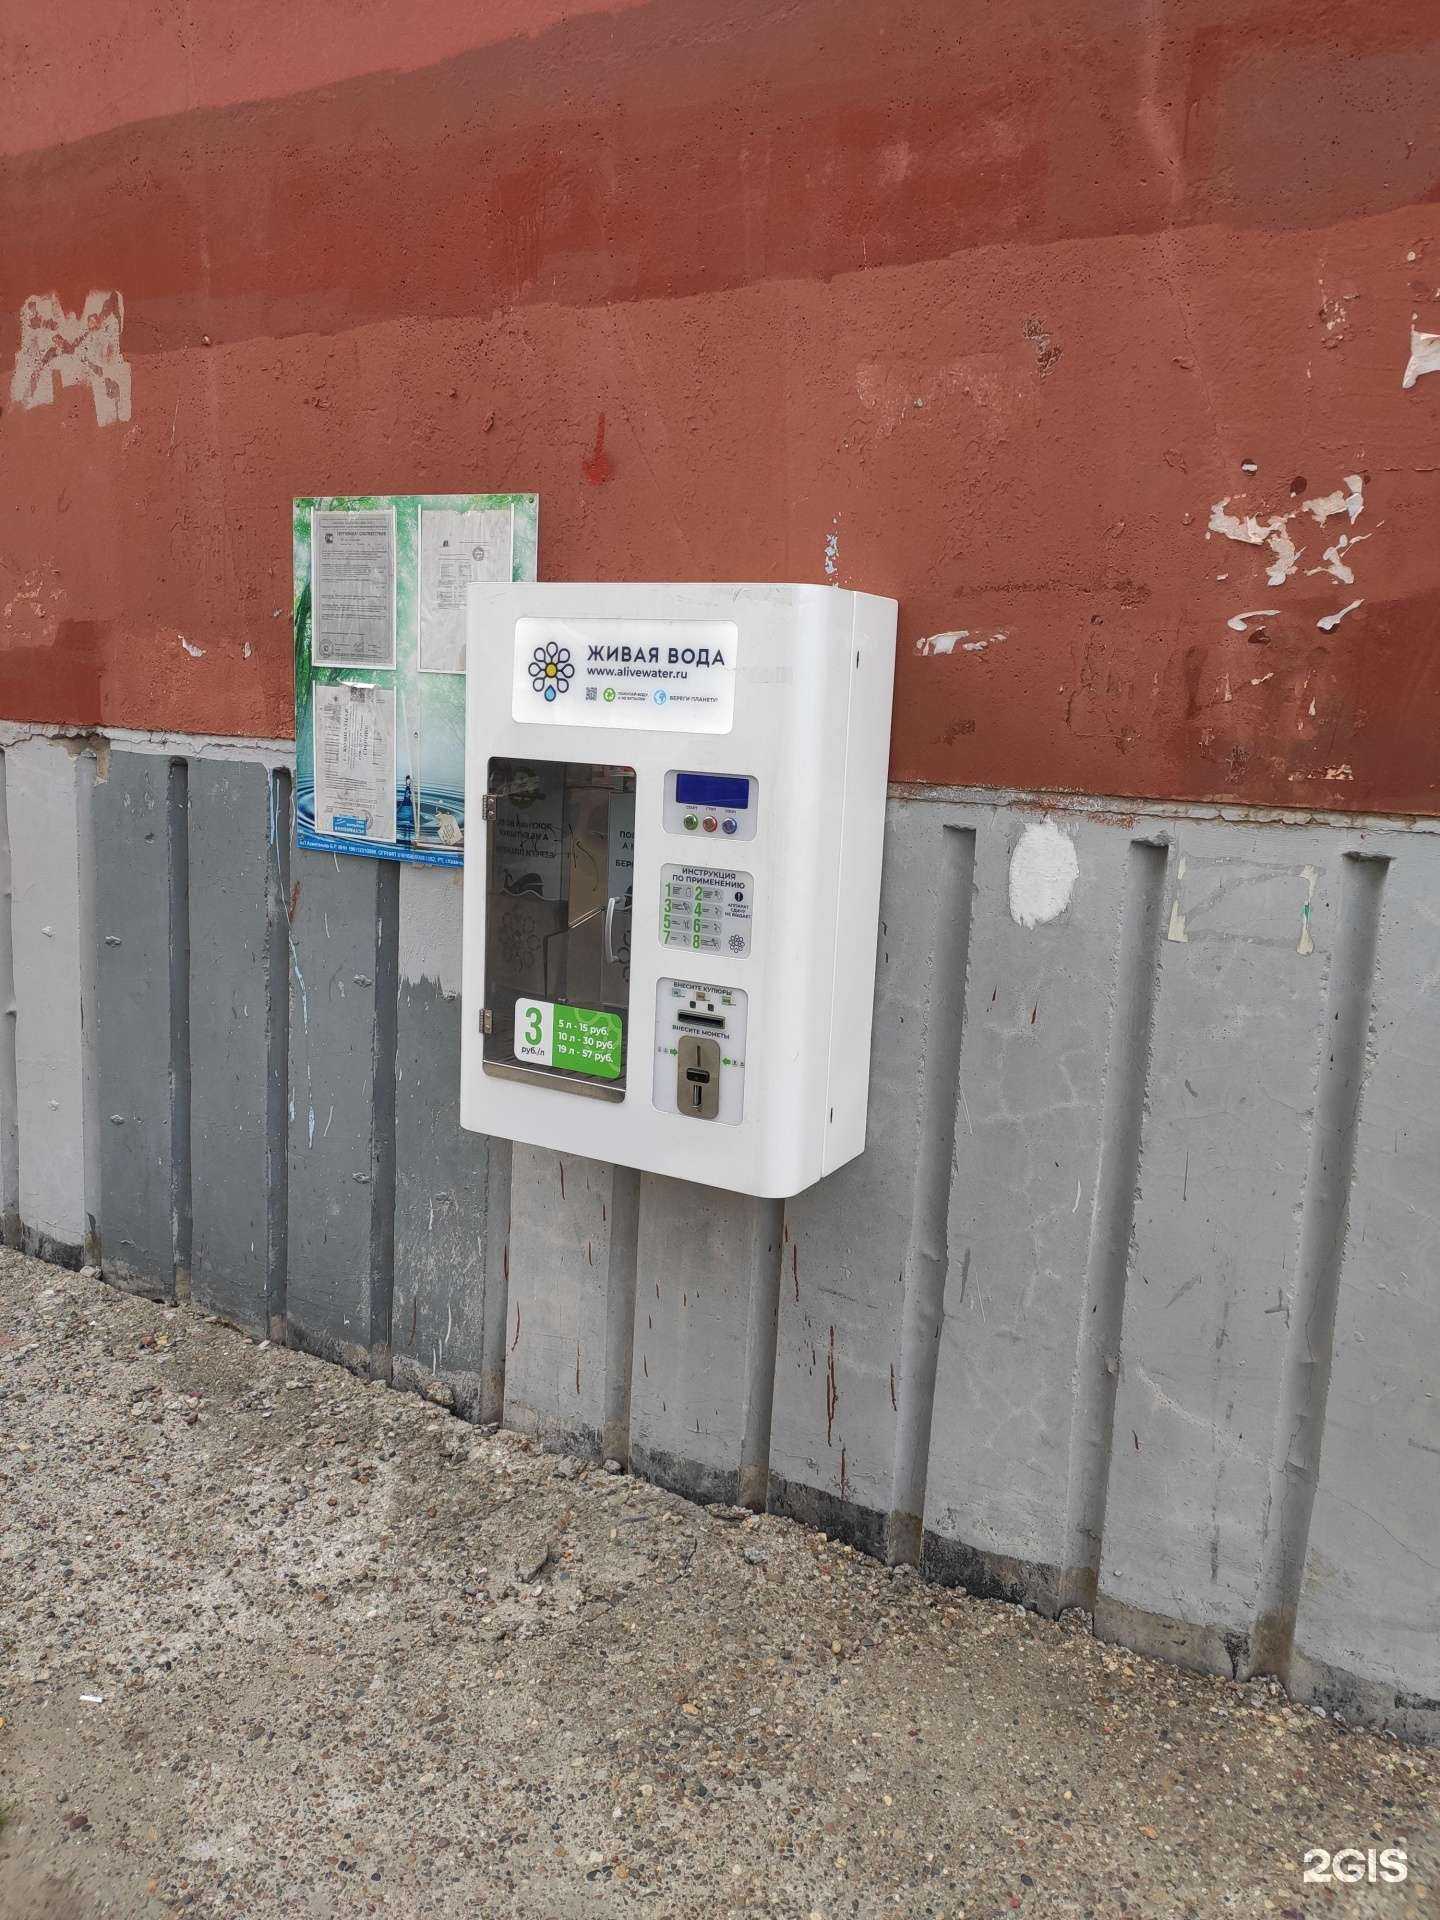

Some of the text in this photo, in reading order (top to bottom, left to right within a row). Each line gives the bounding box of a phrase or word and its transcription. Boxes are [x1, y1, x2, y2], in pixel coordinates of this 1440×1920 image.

[587, 645, 725, 667] ЖИВАЯ ВОДА
[587, 666, 688, 679] www.alivewater.ru
[672, 874, 746, 889] ПО ПРИМЕНЕНИЮ
[682, 868, 736, 880] ИНСТРУКЦИЯ
[665, 882, 671, 897] 1
[695, 886, 703, 901] 2
[664, 898, 672, 913] 3
[694, 902, 702, 917] 4
[664, 914, 671, 929] 5
[693, 919, 701, 933] 6
[663, 930, 671, 945] 7
[693, 934, 700, 949] 8
[673, 981, 732, 996] ВНЕСИТЕ КУПЮРЫ
[525, 1007, 542, 1045] 3
[558, 1019, 564, 1028] 5
[579, 1023, 588, 1032] 15
[590, 1026, 609, 1036] руб.
[672, 1024, 730, 1039] ВНЕСИТЕ МОНЕТЫ
[558, 1032, 567, 1041] 10
[583, 1036, 594, 1046] 30
[596, 1040, 615, 1050] руб.
[521, 1046, 545, 1056] руб./л
[558, 1044, 567, 1054] 19
[582, 1049, 592, 1059] 57
[594, 1051, 613, 1063] руб.
